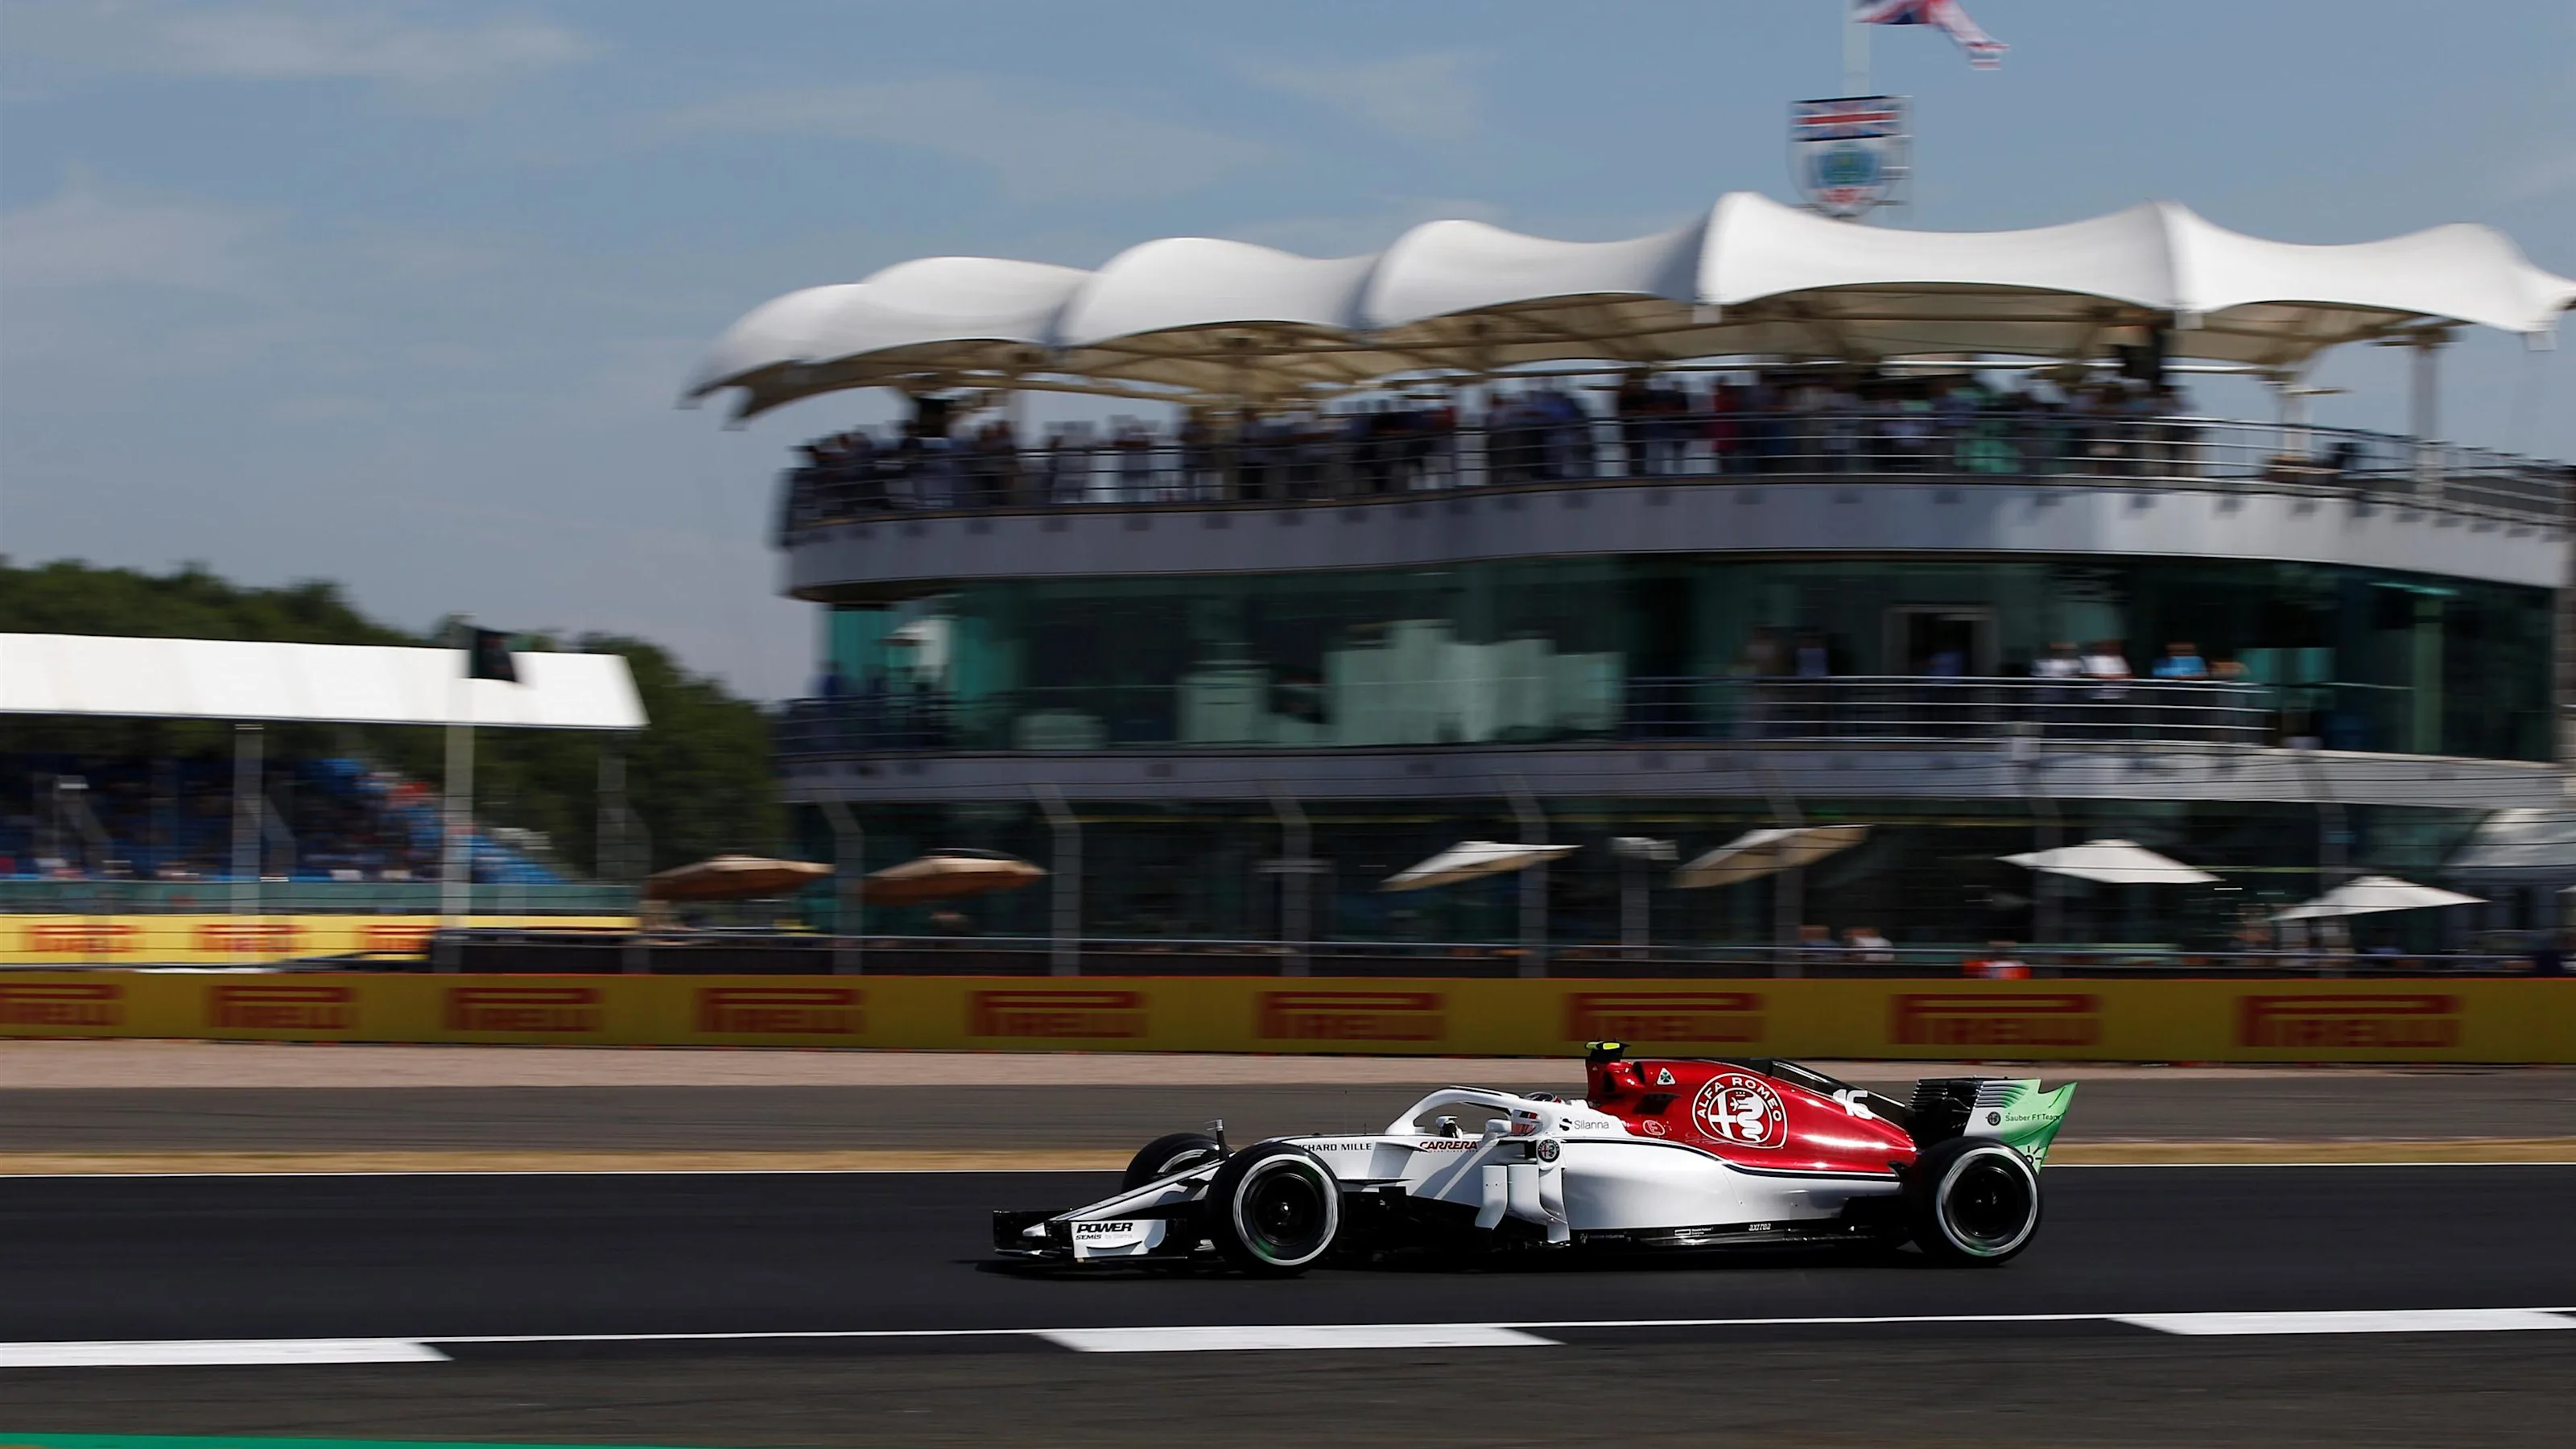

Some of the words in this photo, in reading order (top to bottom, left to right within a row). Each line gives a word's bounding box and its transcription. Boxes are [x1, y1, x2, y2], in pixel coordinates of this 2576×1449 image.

[1697, 1081, 1725, 1119] ALFA
[1732, 1077, 1782, 1122] ROMEO
[1575, 1120, 1609, 1129] Silanna
[1419, 1141, 1478, 1150] CARRERA
[1077, 1222, 1133, 1233] POWER
